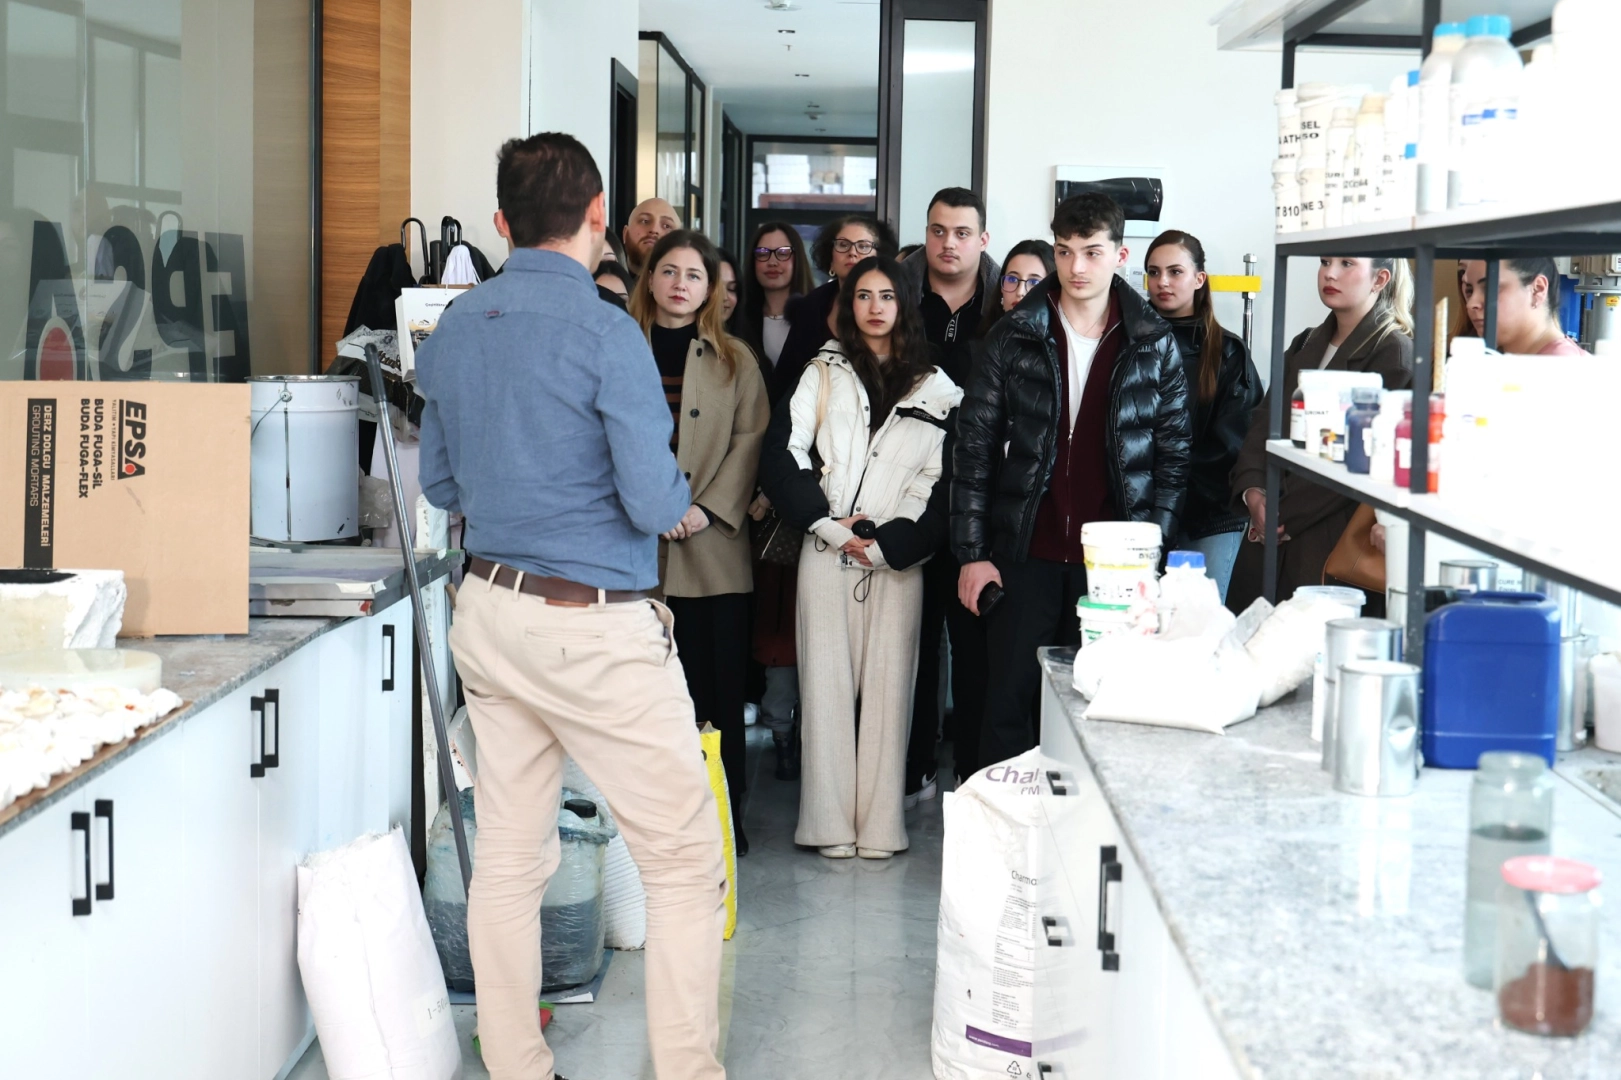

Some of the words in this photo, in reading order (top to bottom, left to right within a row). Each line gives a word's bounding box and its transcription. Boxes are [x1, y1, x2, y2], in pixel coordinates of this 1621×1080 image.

[30, 405, 41, 456] GROUTING
[43, 405, 53, 432] DERZ
[80, 398, 91, 432] BUDA
[93, 398, 104, 432] BUDA
[118, 399, 147, 480] EPSA
[42, 434, 52, 469] DOLGU
[78, 434, 90, 498] FUGA-FLEX
[29, 458, 40, 507] MORTARS
[40, 474, 51, 547] MALZEMELERİ
